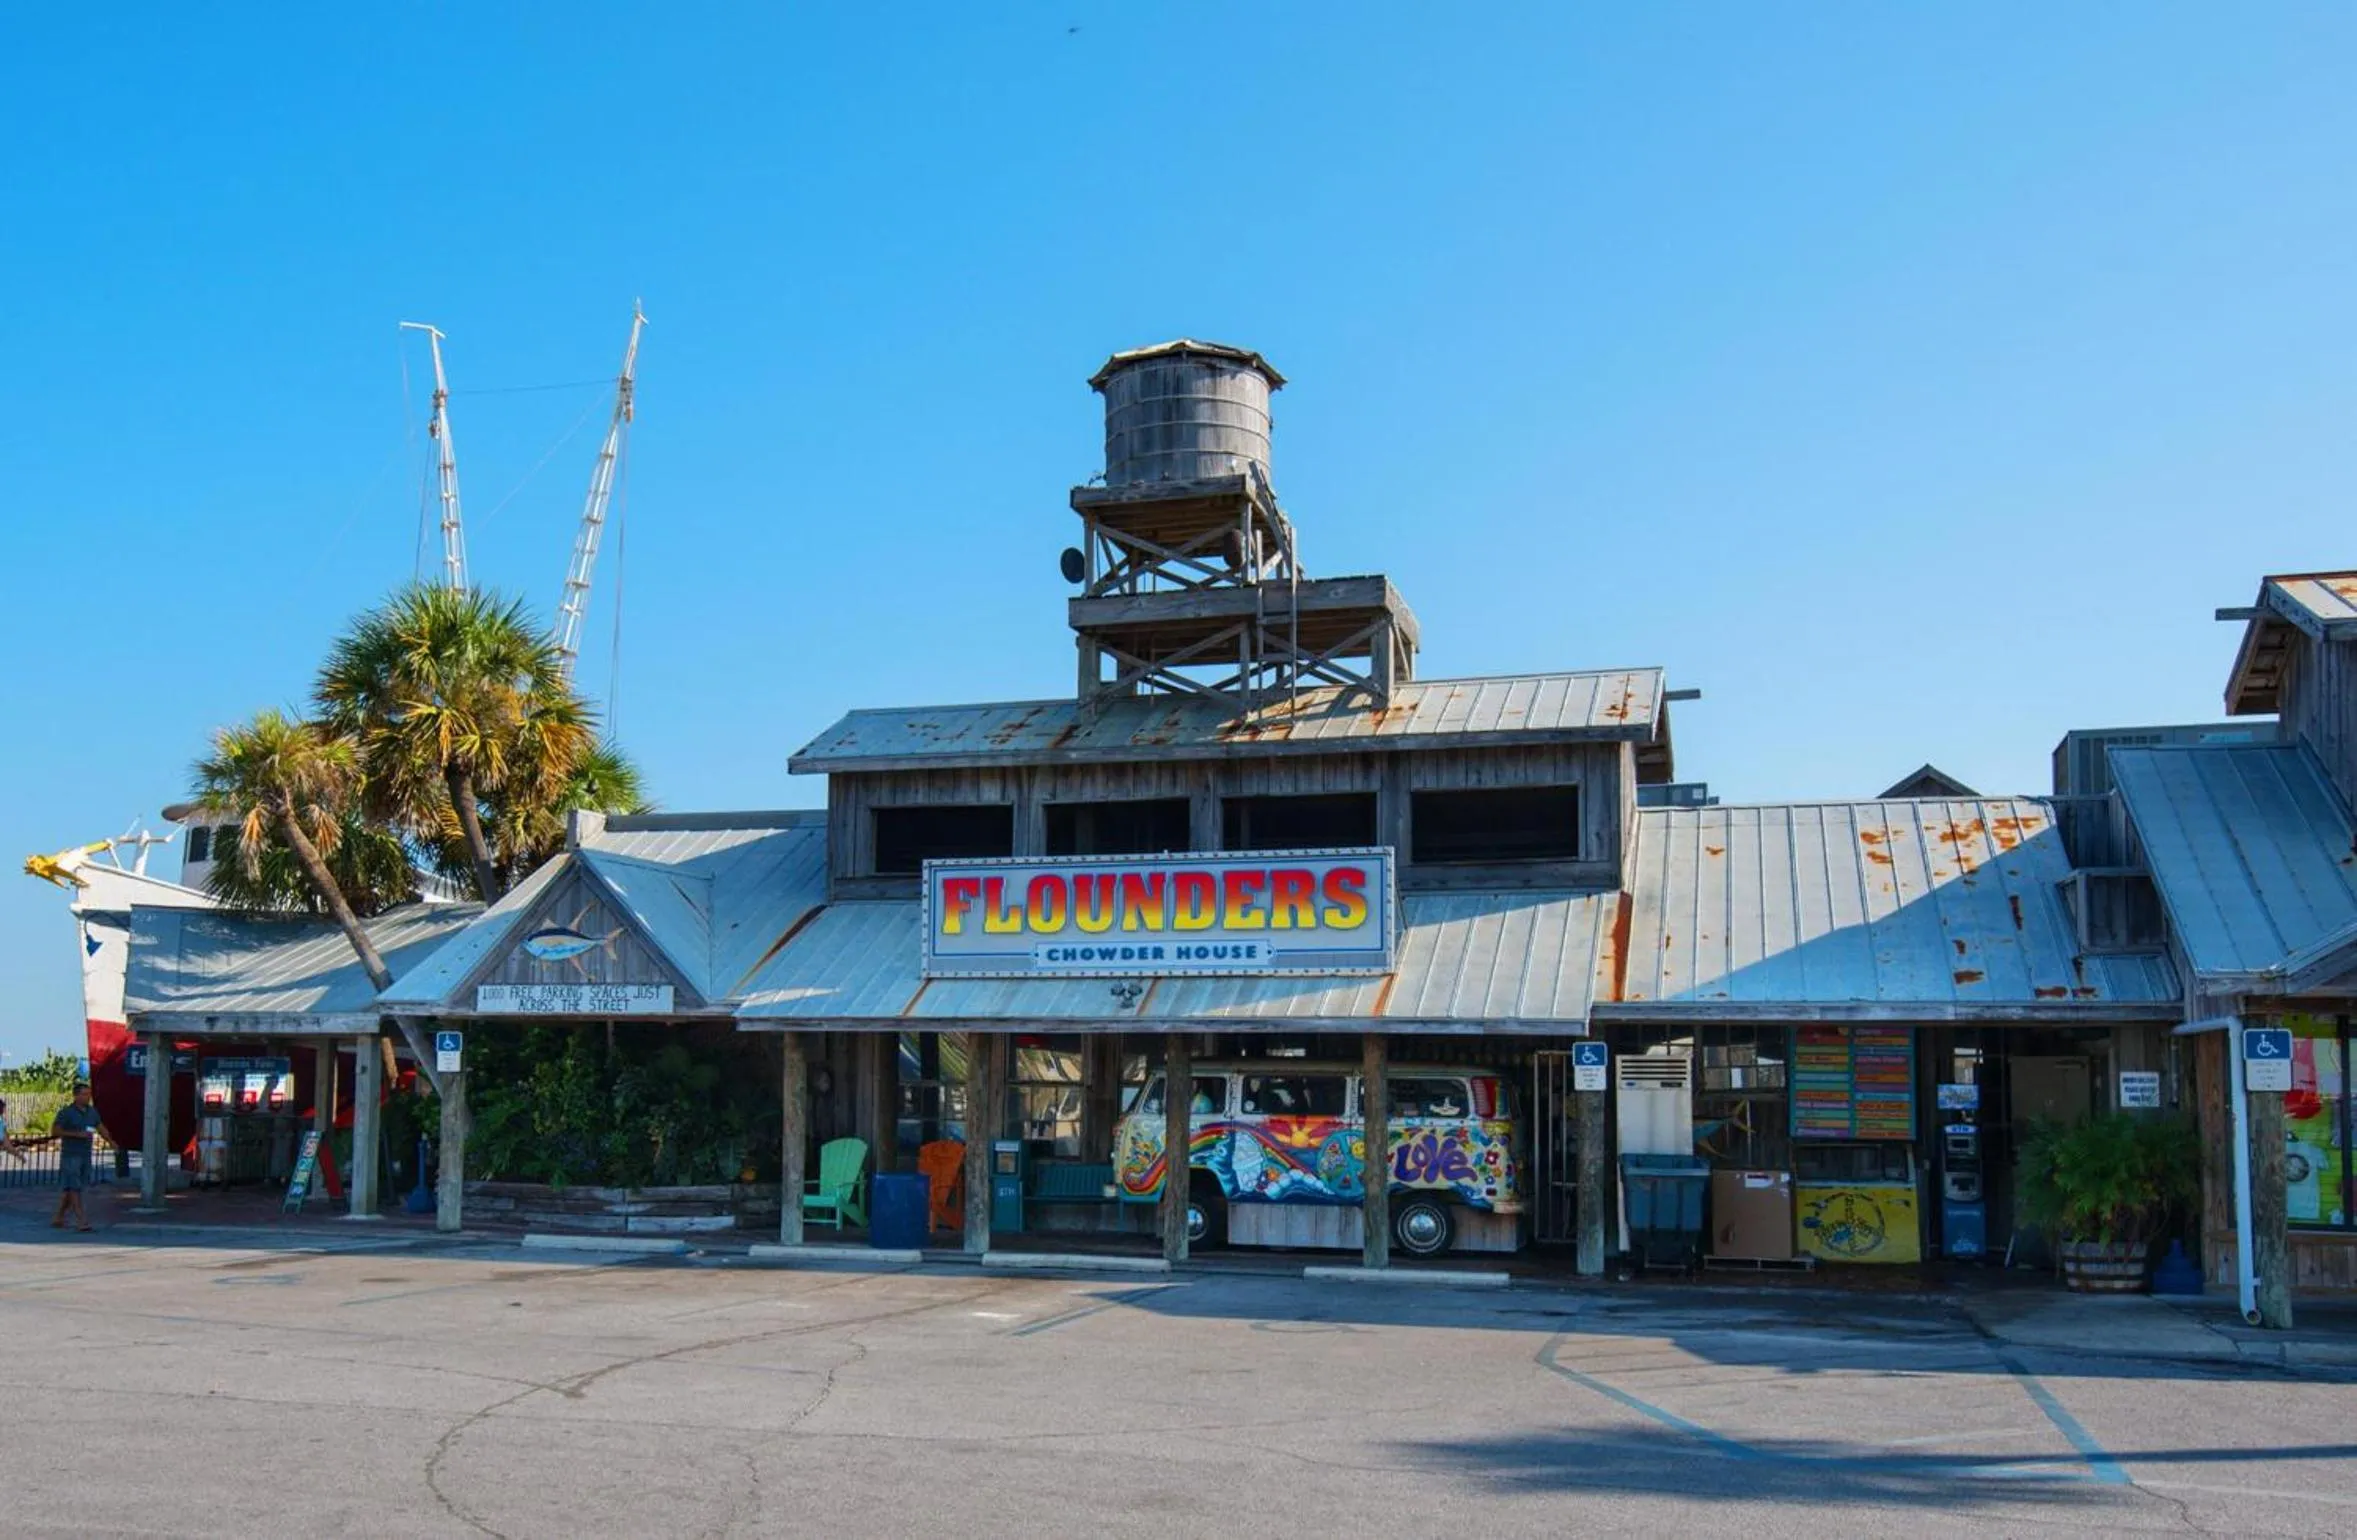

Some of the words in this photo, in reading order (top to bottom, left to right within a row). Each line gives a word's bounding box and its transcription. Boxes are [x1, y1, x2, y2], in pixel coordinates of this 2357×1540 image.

[941, 867, 1369, 935] FLOUNDERS
[1046, 946, 1165, 962] CHOWDER
[1176, 945, 1258, 960] HOUSE
[510, 985, 533, 999] FREE
[540, 984, 583, 1000] PARKING
[589, 984, 628, 999] SPACES
[633, 984, 662, 1000] JUST
[518, 999, 555, 1012] ACROSS
[562, 999, 581, 1012] THE
[589, 999, 632, 1012] STREET
